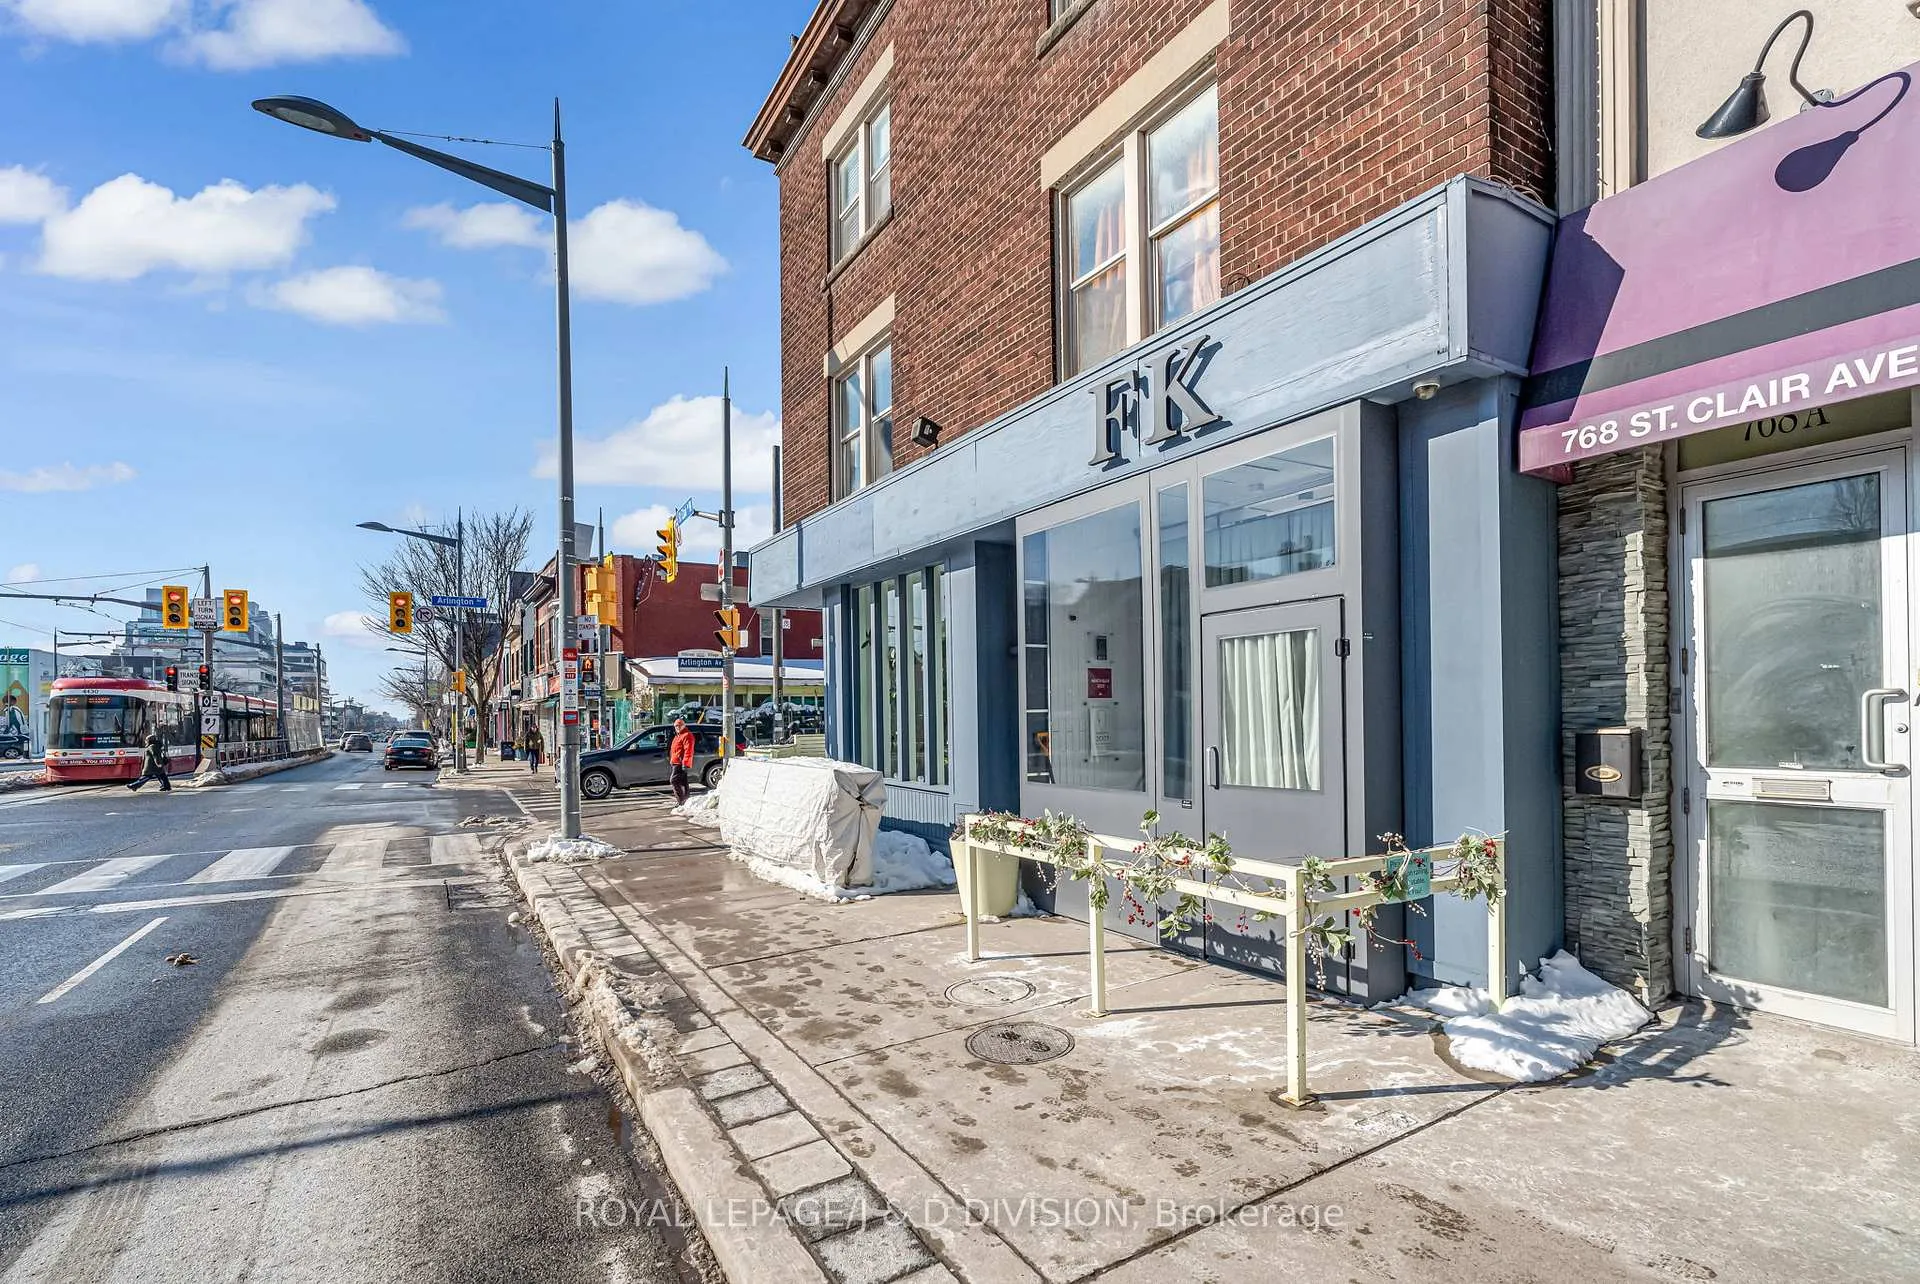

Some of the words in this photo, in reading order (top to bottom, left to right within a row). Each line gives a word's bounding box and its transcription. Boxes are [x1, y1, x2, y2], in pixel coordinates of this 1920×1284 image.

[1088, 335, 1224, 466] FK
[1561, 420, 1619, 453] 768
[1629, 405, 1677, 439] ST.
[1687, 372, 1810, 424] CLAIR
[1823, 344, 1919, 395] AVE
[438, 597, 474, 606] Arlington
[680, 659, 713, 668] Arlington
[180, 671, 199, 679] TRANS
